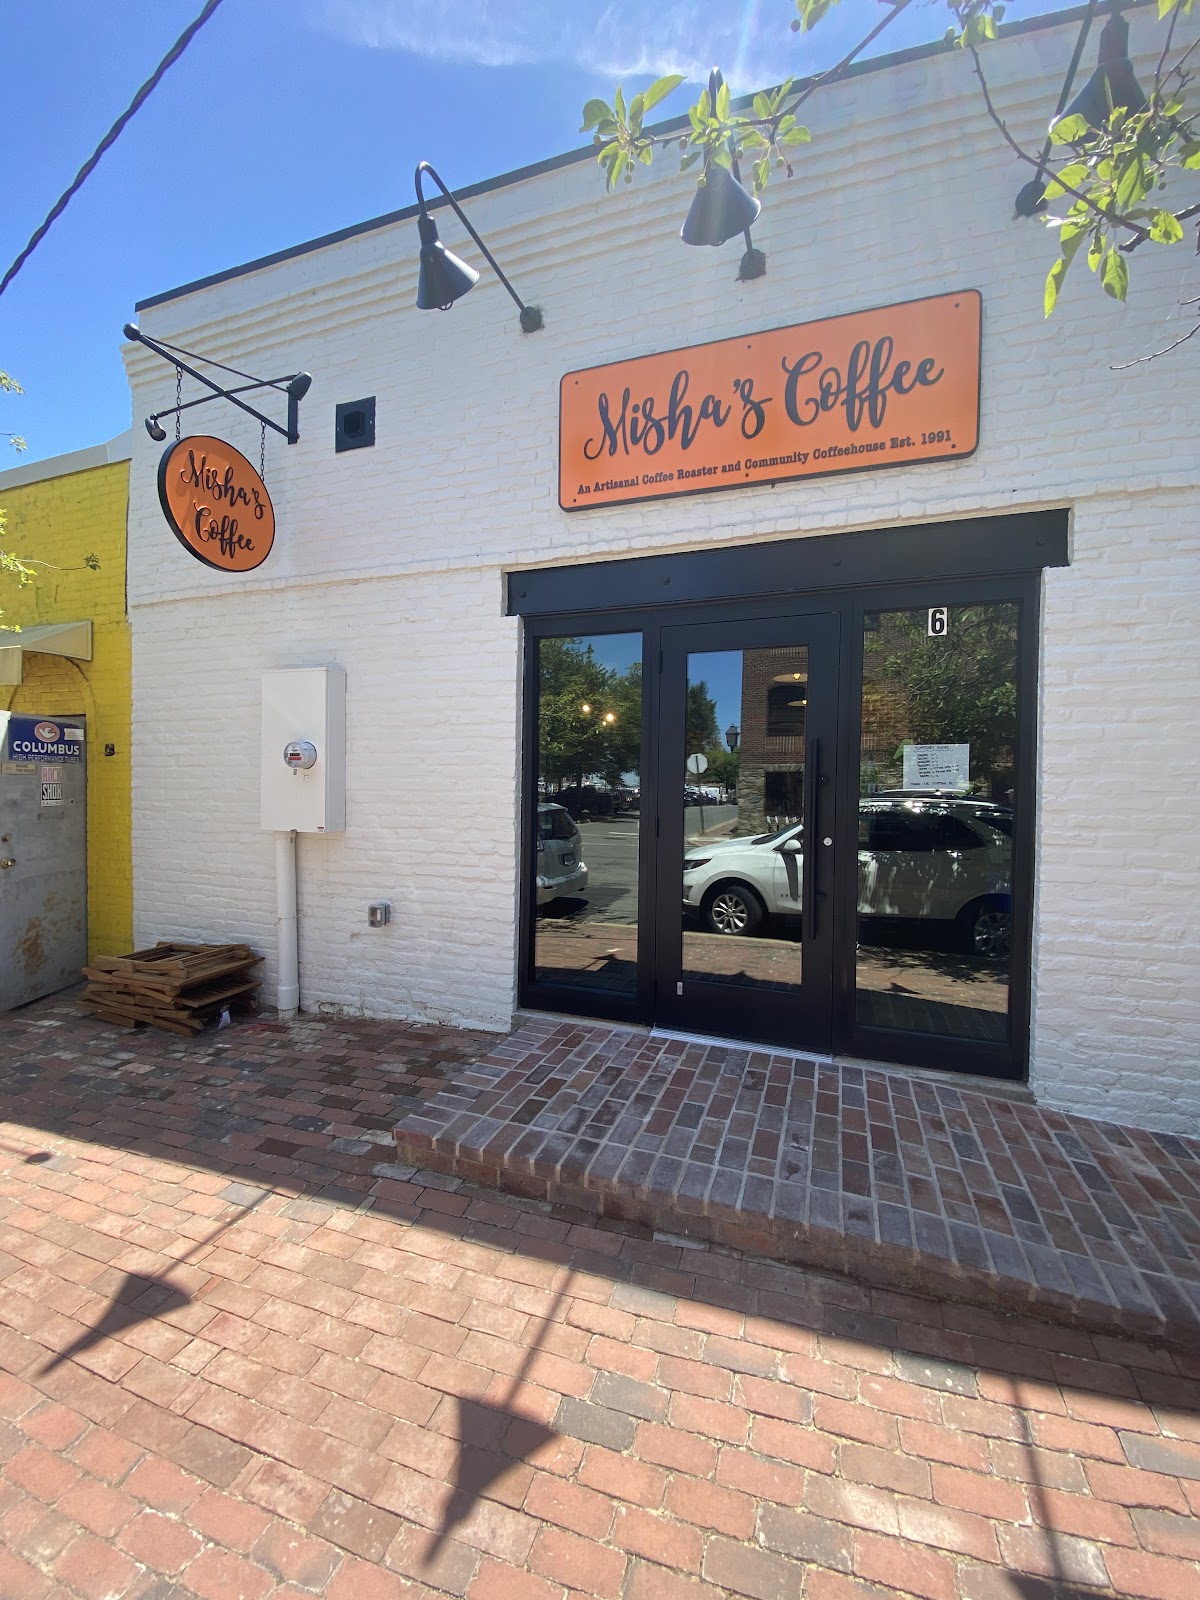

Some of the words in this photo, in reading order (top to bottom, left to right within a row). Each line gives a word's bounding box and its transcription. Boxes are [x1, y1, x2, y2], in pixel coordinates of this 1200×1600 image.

[583, 369, 773, 460] Misha's
[781, 335, 945, 432] Coffee
[577, 484, 591, 494] An
[593, 475, 639, 492] Artisanal
[642, 471, 674, 485] Coffee
[677, 465, 718, 480] Roaster
[721, 460, 741, 473] and
[744, 450, 809, 470] Community
[812, 439, 886, 460] Coffeehouse
[890, 436, 915, 449] Est.
[920, 429, 952, 445] 1991
[180, 449, 266, 520] Misha's
[193, 500, 255, 559] Coffee
[930, 608, 945, 635] 6
[12, 753, 27, 761] HIGH
[28, 754, 64, 763] PERFORMANCE
[13, 740, 80, 755] COLUMBUS
[42, 767, 62, 782] ROCK
[42, 783, 62, 800] SHOX
